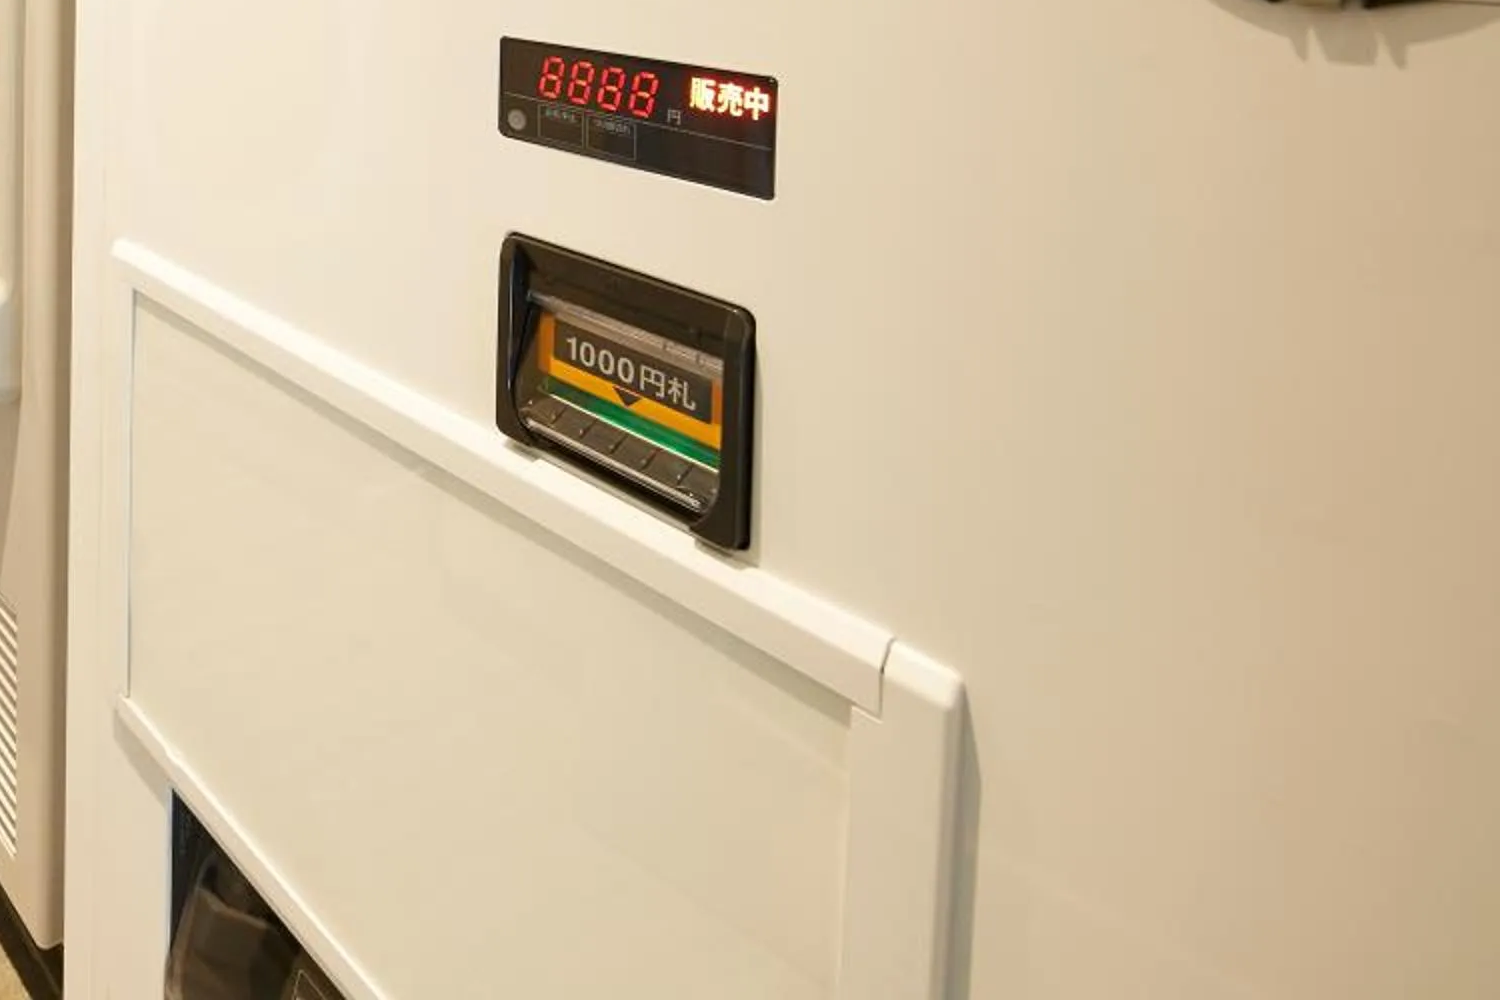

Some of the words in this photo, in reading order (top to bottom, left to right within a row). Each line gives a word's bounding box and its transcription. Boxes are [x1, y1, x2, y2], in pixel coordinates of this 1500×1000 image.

[688, 75, 771, 121] 販売中
[565, 335, 698, 412] 1000円札
